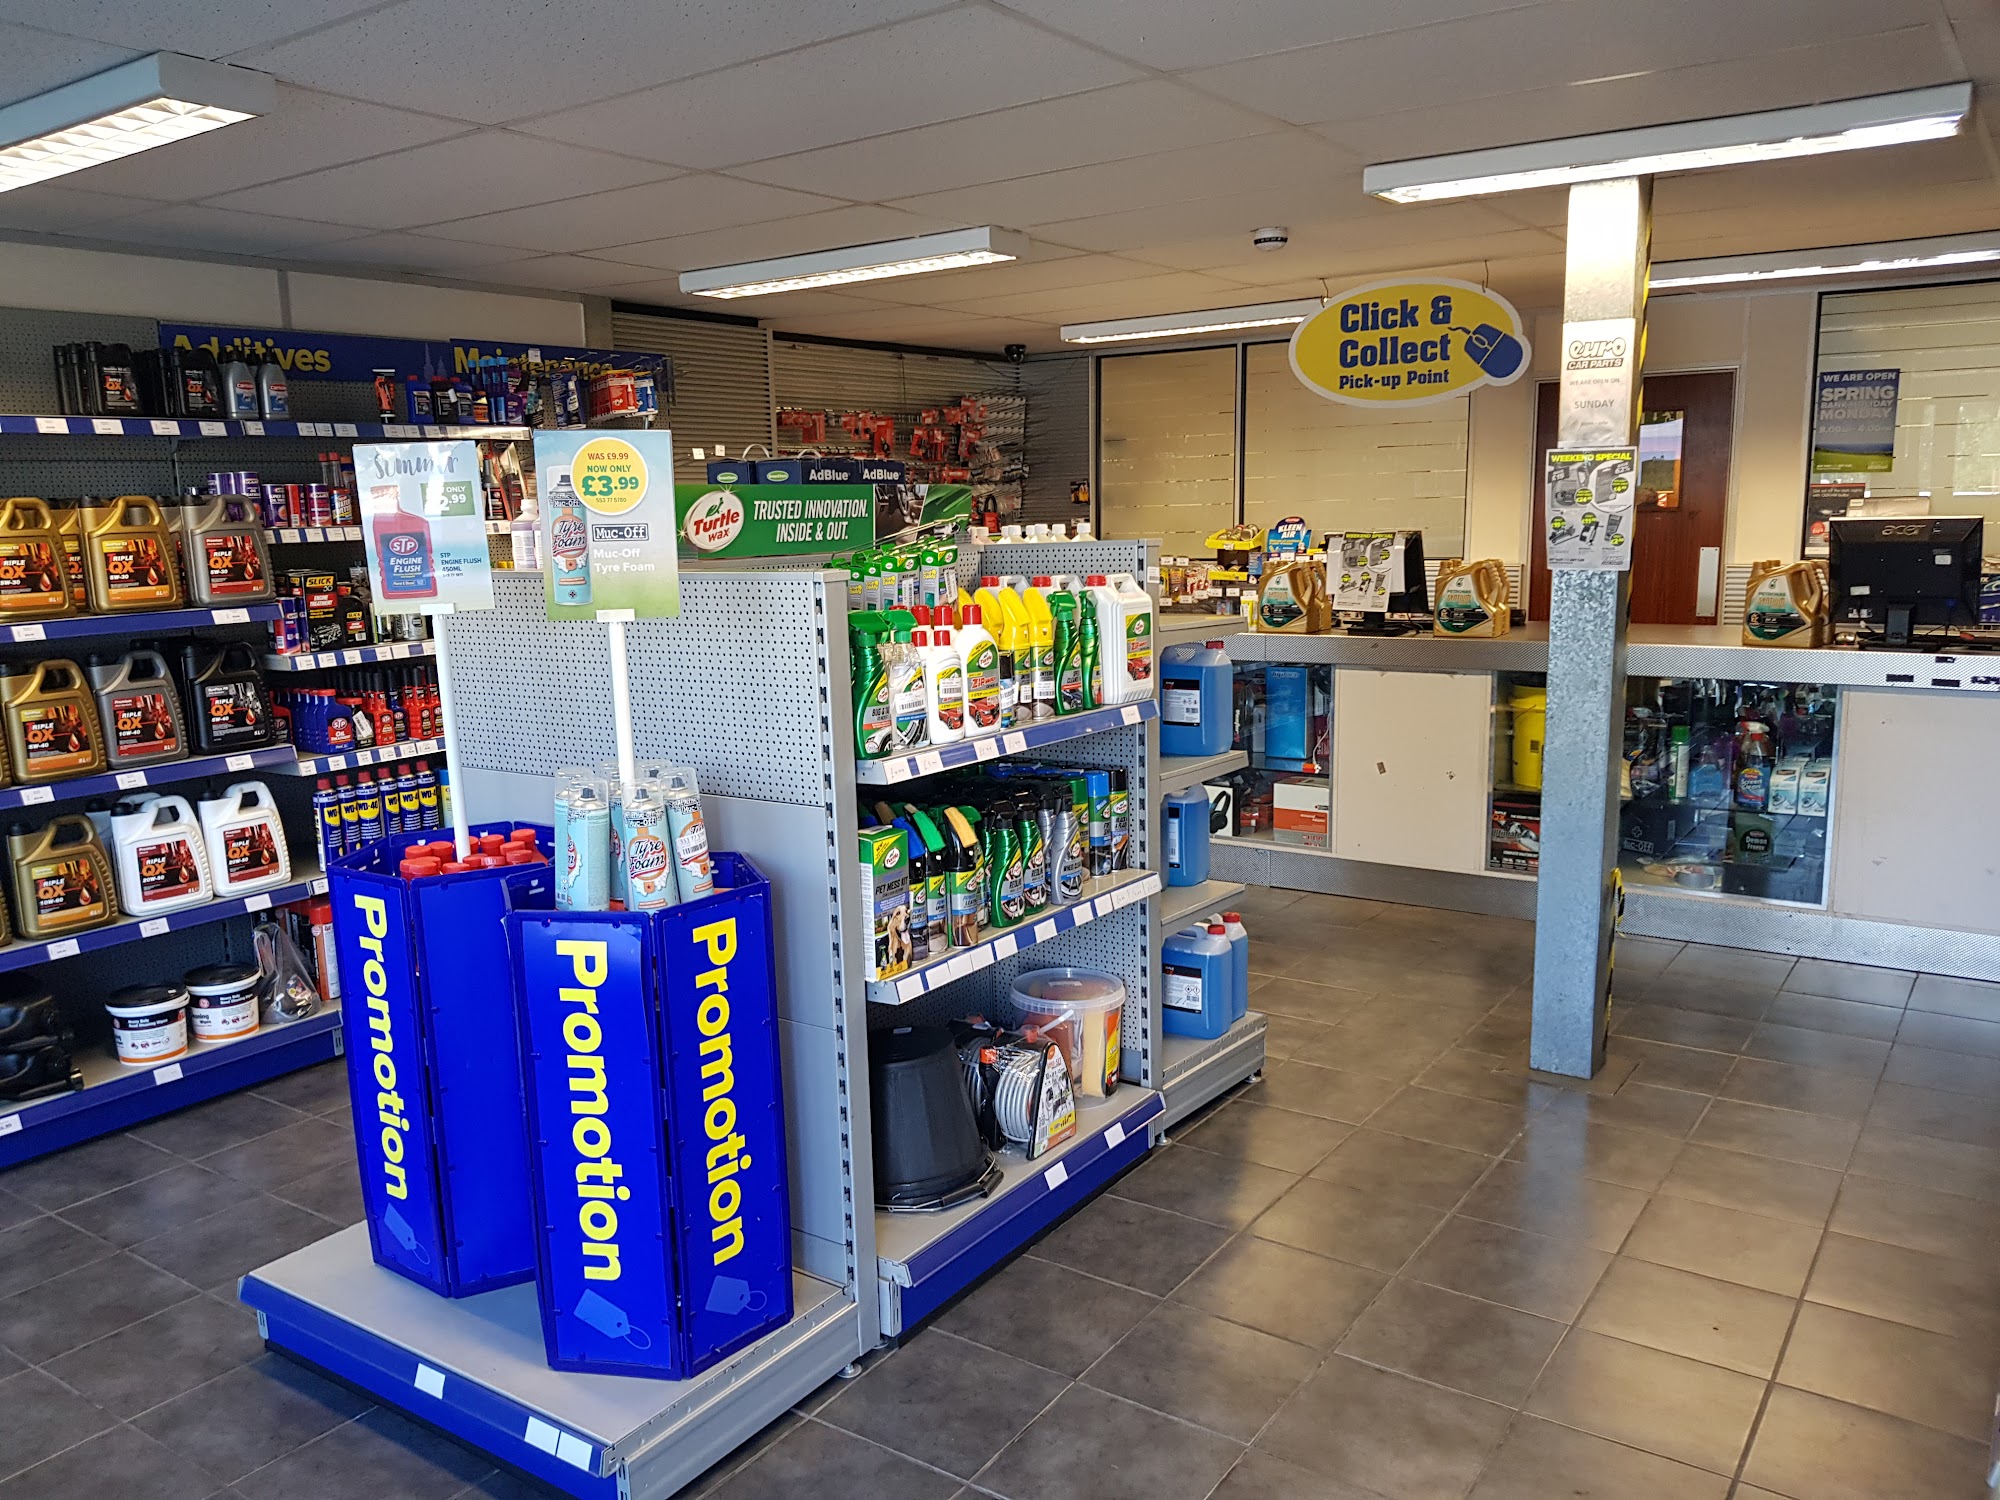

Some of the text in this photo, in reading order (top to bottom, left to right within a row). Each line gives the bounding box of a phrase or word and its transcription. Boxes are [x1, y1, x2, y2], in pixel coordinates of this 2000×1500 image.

[1340, 295, 1452, 333] Click &
[1339, 333, 1451, 368] Collect
[1569, 337, 1626, 359] euro
[1568, 358, 1622, 370] CAR PARTS
[1339, 369, 1449, 389] Pick-up Point
[1866, 372, 1897, 380] OPEN
[1821, 385, 1895, 401] SPRING
[1574, 400, 1615, 409] SUNDAY
[1820, 408, 1892, 420] MONDAY
[1551, 452, 1632, 462] WEEKEND SPECIAL
[373, 453, 459, 479] Summr
[809, 468, 848, 481] AdBlue
[863, 467, 900, 480] AdBlue
[582, 475, 639, 497] £3.99
[437, 493, 466, 511] 2.99
[753, 499, 868, 520] TRUSTED INNOVATION.
[559, 520, 585, 538] Tyre
[694, 508, 740, 537] Turtle
[1278, 524, 1302, 533] KLEEN
[596, 527, 645, 539] Muc-Off
[708, 527, 730, 543] wax
[776, 521, 849, 543] INSIDE & OUT.
[1281, 531, 1297, 539] AIR
[1881, 524, 1926, 536] acer
[393, 538, 415, 553] STP
[552, 535, 586, 548] Foam
[107, 553, 134, 563] TRIPLE
[208, 549, 232, 558] TRIPLE
[593, 549, 641, 558] Muc-Off
[109, 561, 135, 574] QX
[209, 556, 233, 569] QX
[390, 557, 423, 565] ENGINE
[394, 565, 421, 573] FLUSH
[594, 562, 656, 574] Tyre Foam
[308, 577, 332, 585] SLICK
[210, 697, 233, 706] TRIPLE
[116, 710, 142, 720] TRIPLE
[211, 703, 234, 717] QX
[25, 721, 54, 732] TRIPLE
[117, 717, 143, 731] QX
[332, 719, 347, 729] STP
[27, 728, 55, 743] QX
[358, 801, 378, 811] WD-40
[226, 839, 250, 848] TRIPLE
[634, 840, 662, 859] Tyre
[1624, 840, 1653, 853] uc-Off
[228, 846, 251, 859] QX
[141, 856, 166, 866] TRIPLE
[629, 855, 664, 870] Foam
[142, 863, 167, 877] QX
[36, 877, 66, 888] TRIPLE
[38, 884, 66, 900] QX
[354, 894, 410, 1201] Promotion
[692, 917, 752, 1266] Promotion
[556, 939, 631, 1281] Promotion
